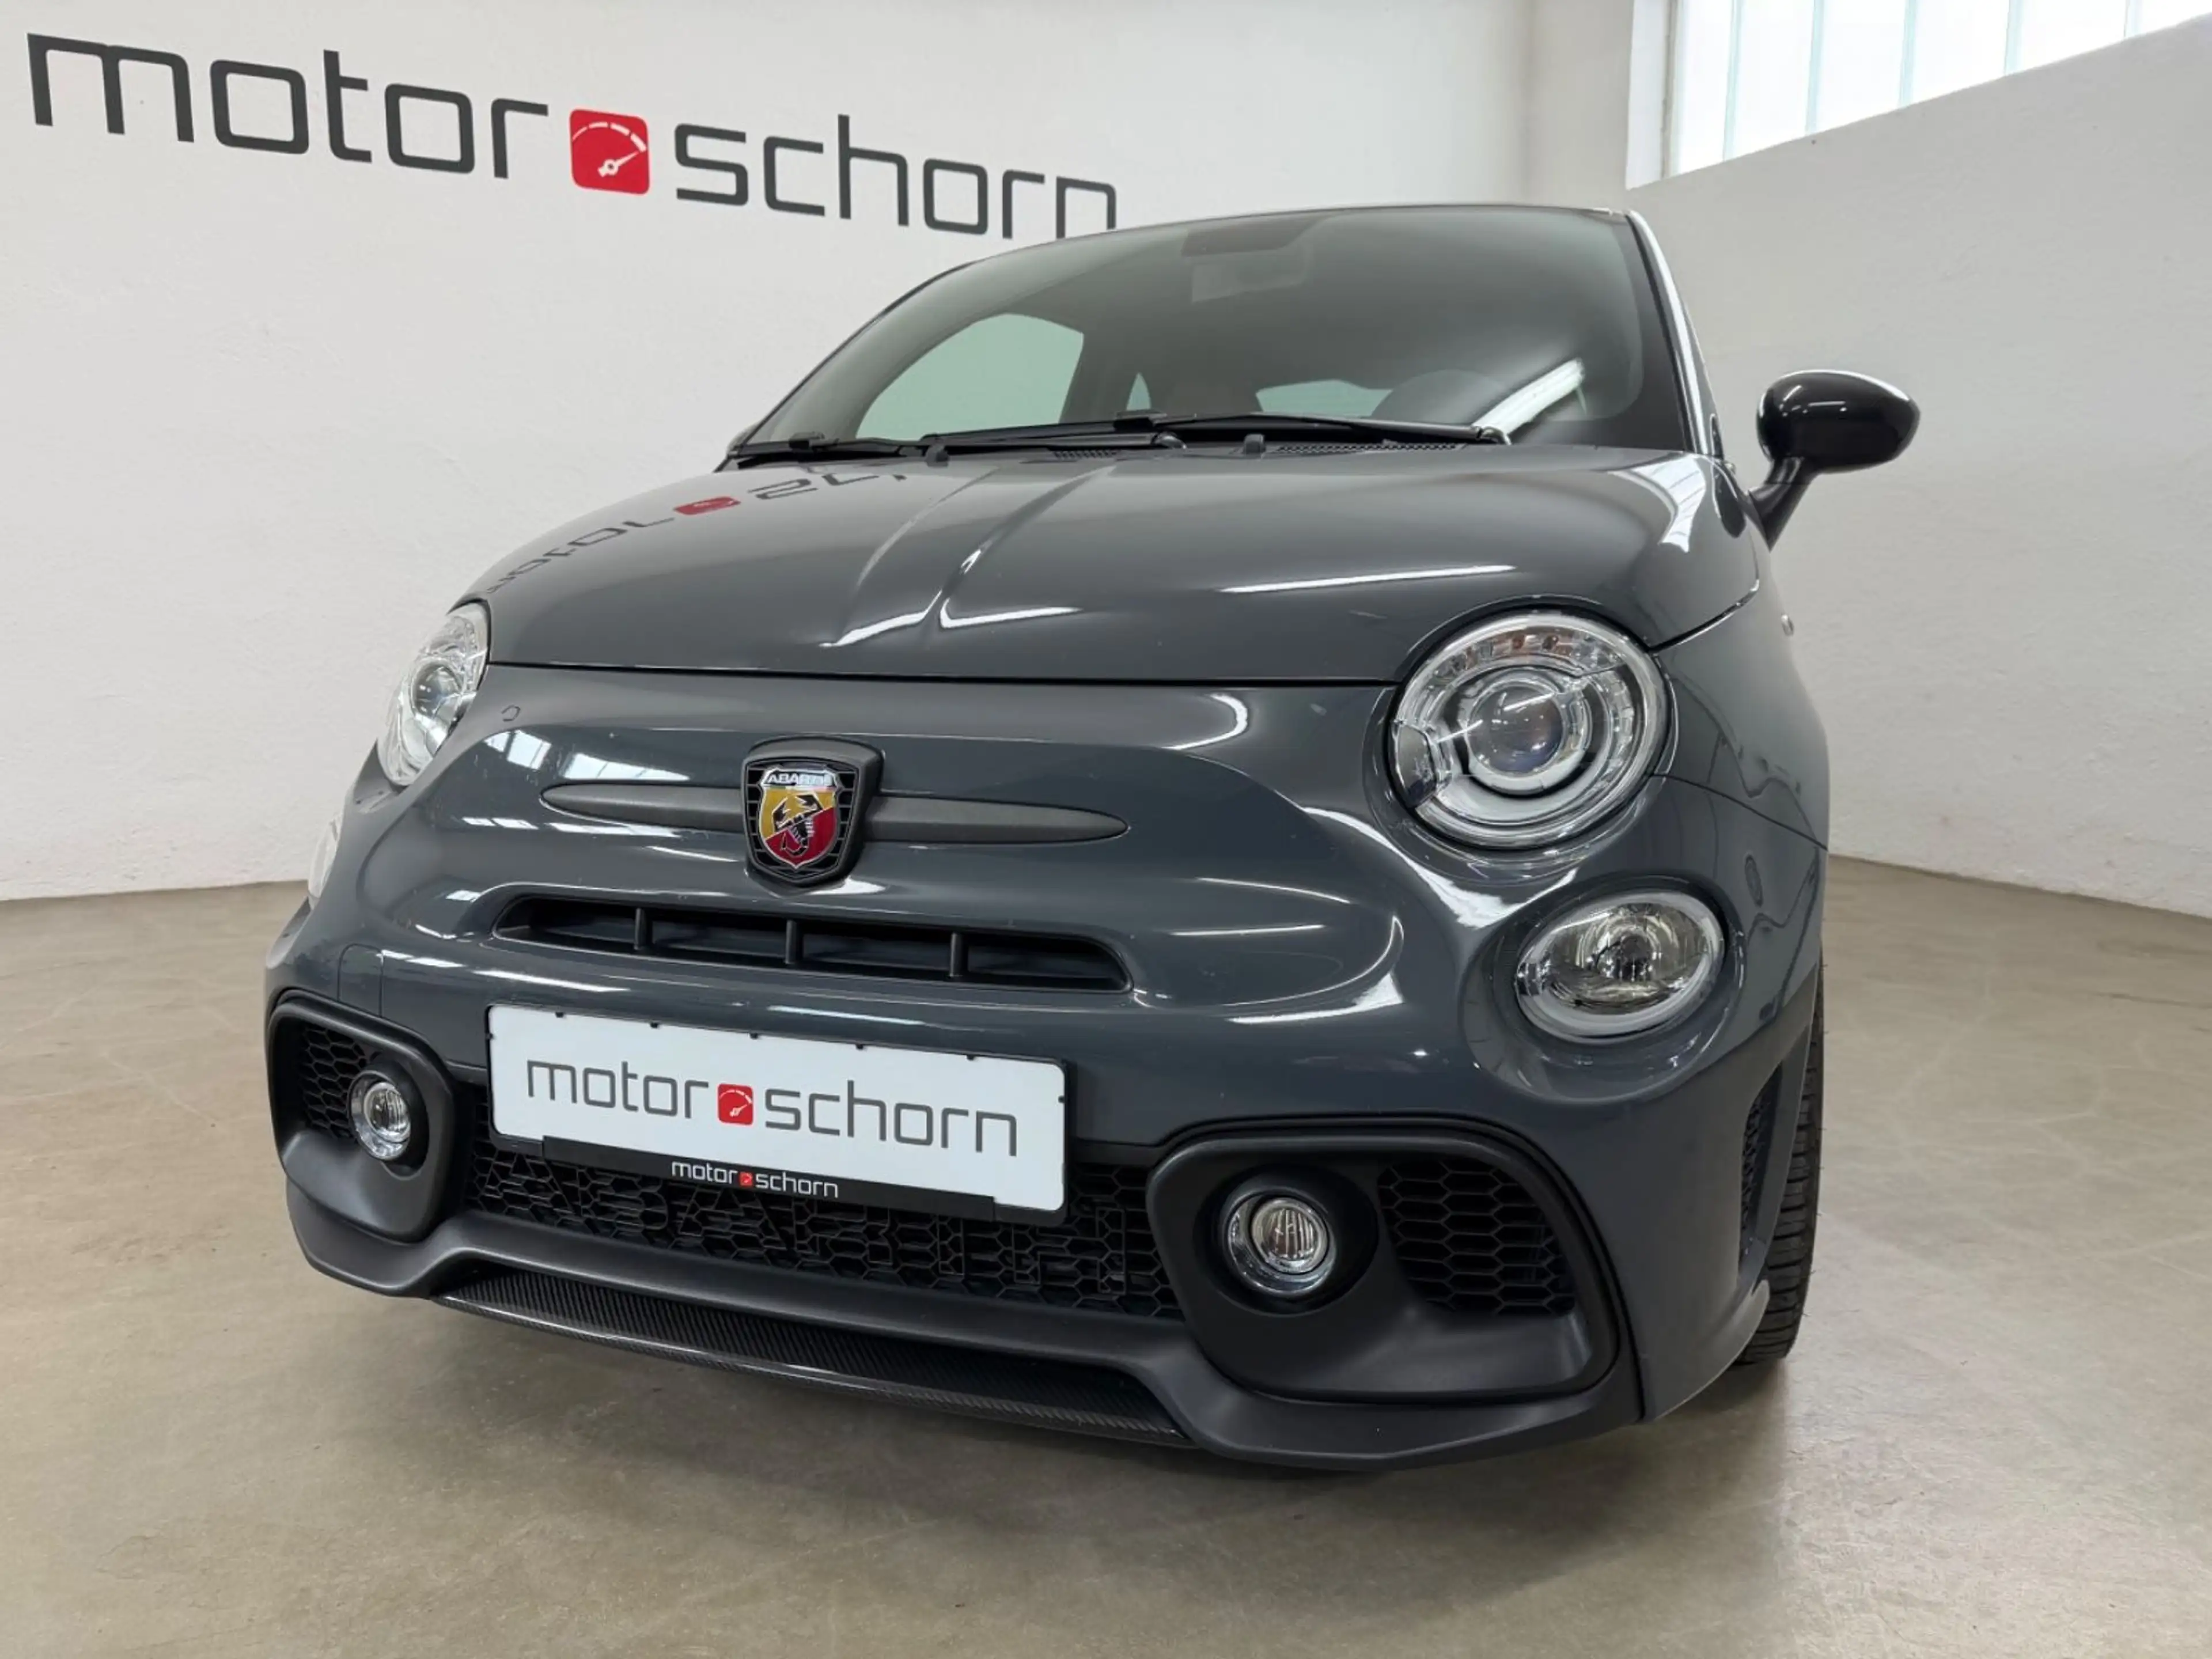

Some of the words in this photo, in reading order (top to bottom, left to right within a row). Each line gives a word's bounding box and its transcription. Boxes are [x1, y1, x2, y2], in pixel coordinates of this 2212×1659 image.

[26, 32, 549, 180] motor
[674, 113, 1117, 240] schorn
[526, 1059, 710, 1120] motor
[764, 1079, 1018, 1157] schorn
[671, 1161, 738, 1184] motor
[755, 1172, 839, 1199] schorn
